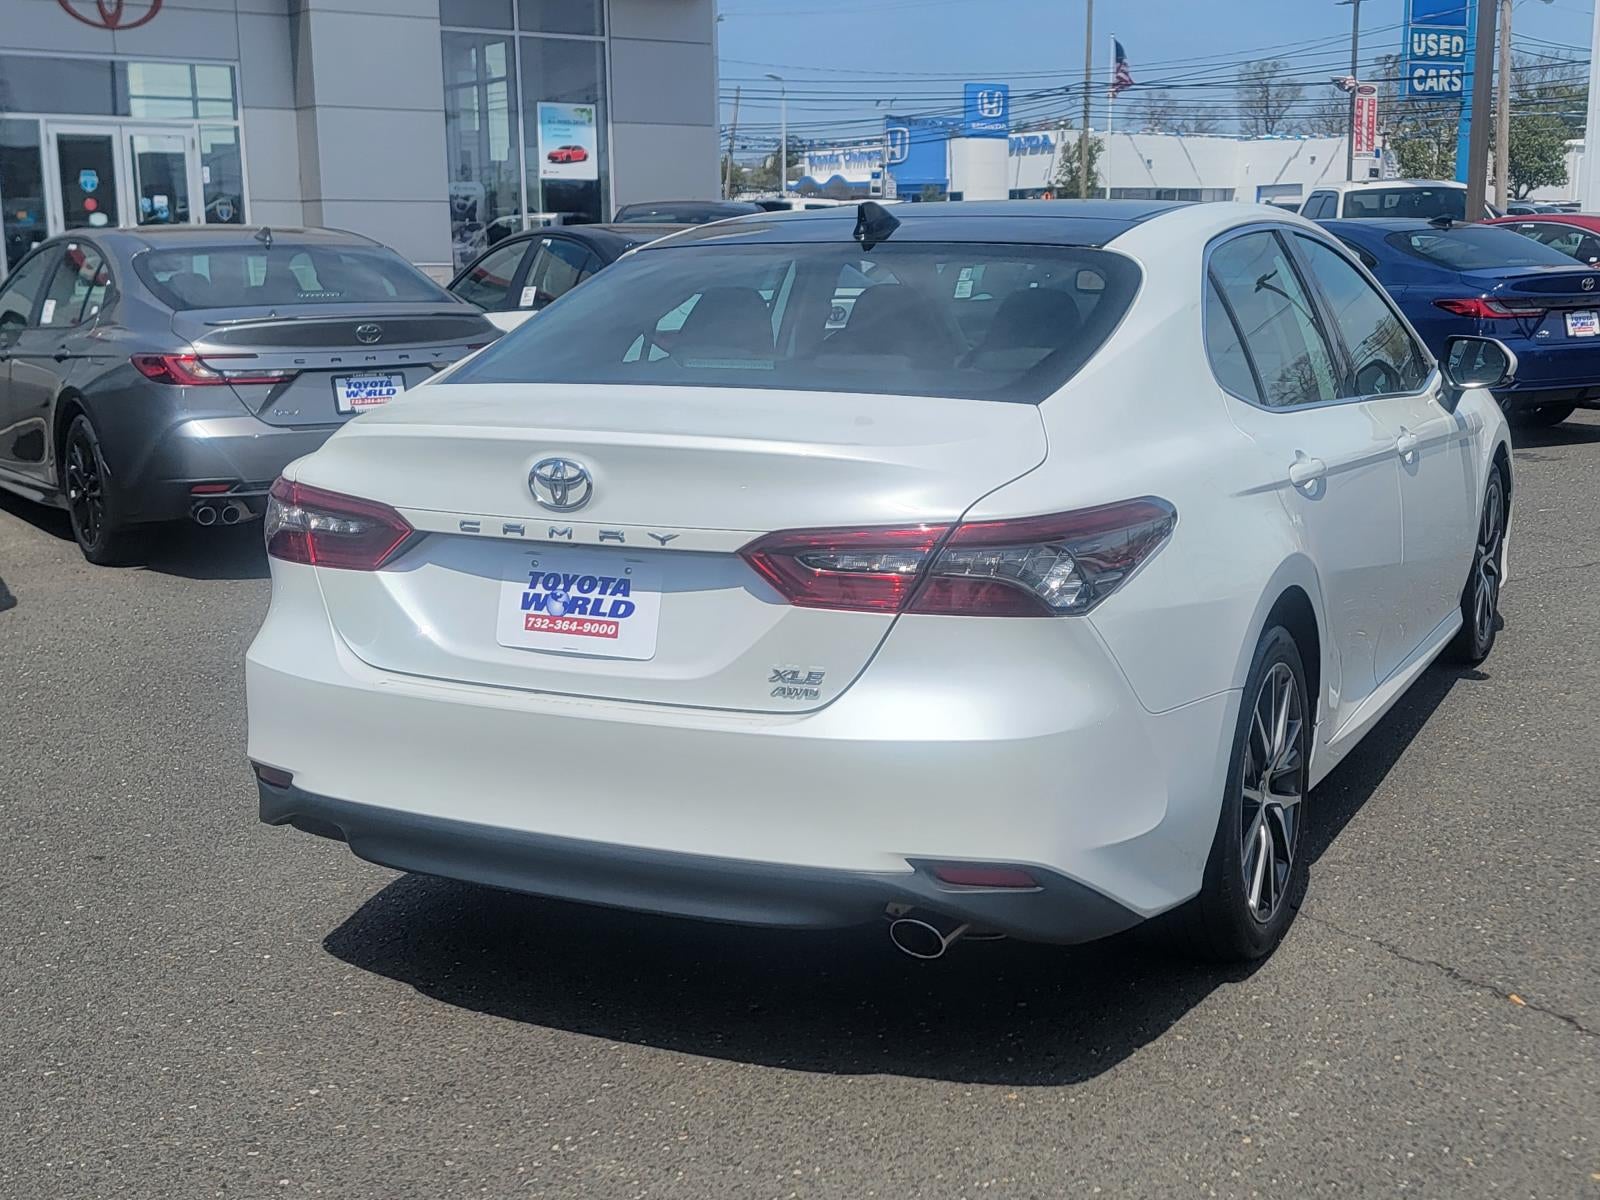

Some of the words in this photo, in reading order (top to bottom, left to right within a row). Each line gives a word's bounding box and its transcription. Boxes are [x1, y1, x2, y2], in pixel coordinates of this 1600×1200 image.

[1413, 33, 1464, 57] USED
[1412, 68, 1462, 91] CARS
[294, 352, 443, 364] CAMRY
[345, 388, 397, 398] WORLD
[346, 380, 393, 389] TOYOTA
[459, 520, 680, 546] CAMRY
[528, 571, 631, 598] TOYOTA
[520, 591, 636, 619] WORLD
[526, 616, 616, 636] 732-364-9000
[768, 669, 825, 685] XLE
[770, 686, 819, 700] AWD
